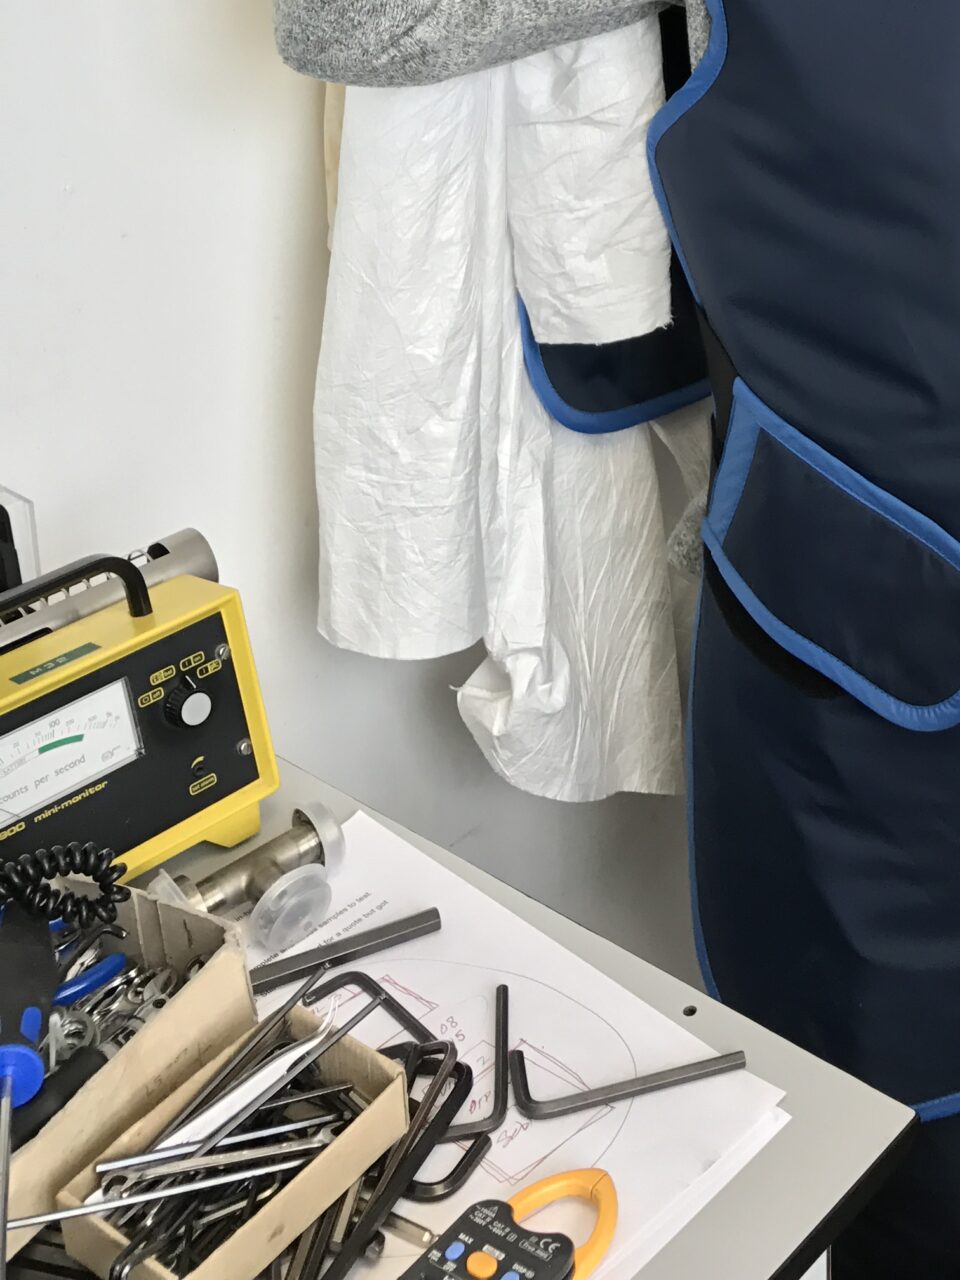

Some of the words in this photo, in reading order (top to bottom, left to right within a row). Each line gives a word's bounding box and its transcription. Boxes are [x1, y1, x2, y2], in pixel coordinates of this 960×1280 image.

[34, 774, 49, 790] per
[54, 754, 86, 777] second
[34, 781, 108, 822] mini-monitor
[458, 1232, 474, 1245] MAX
